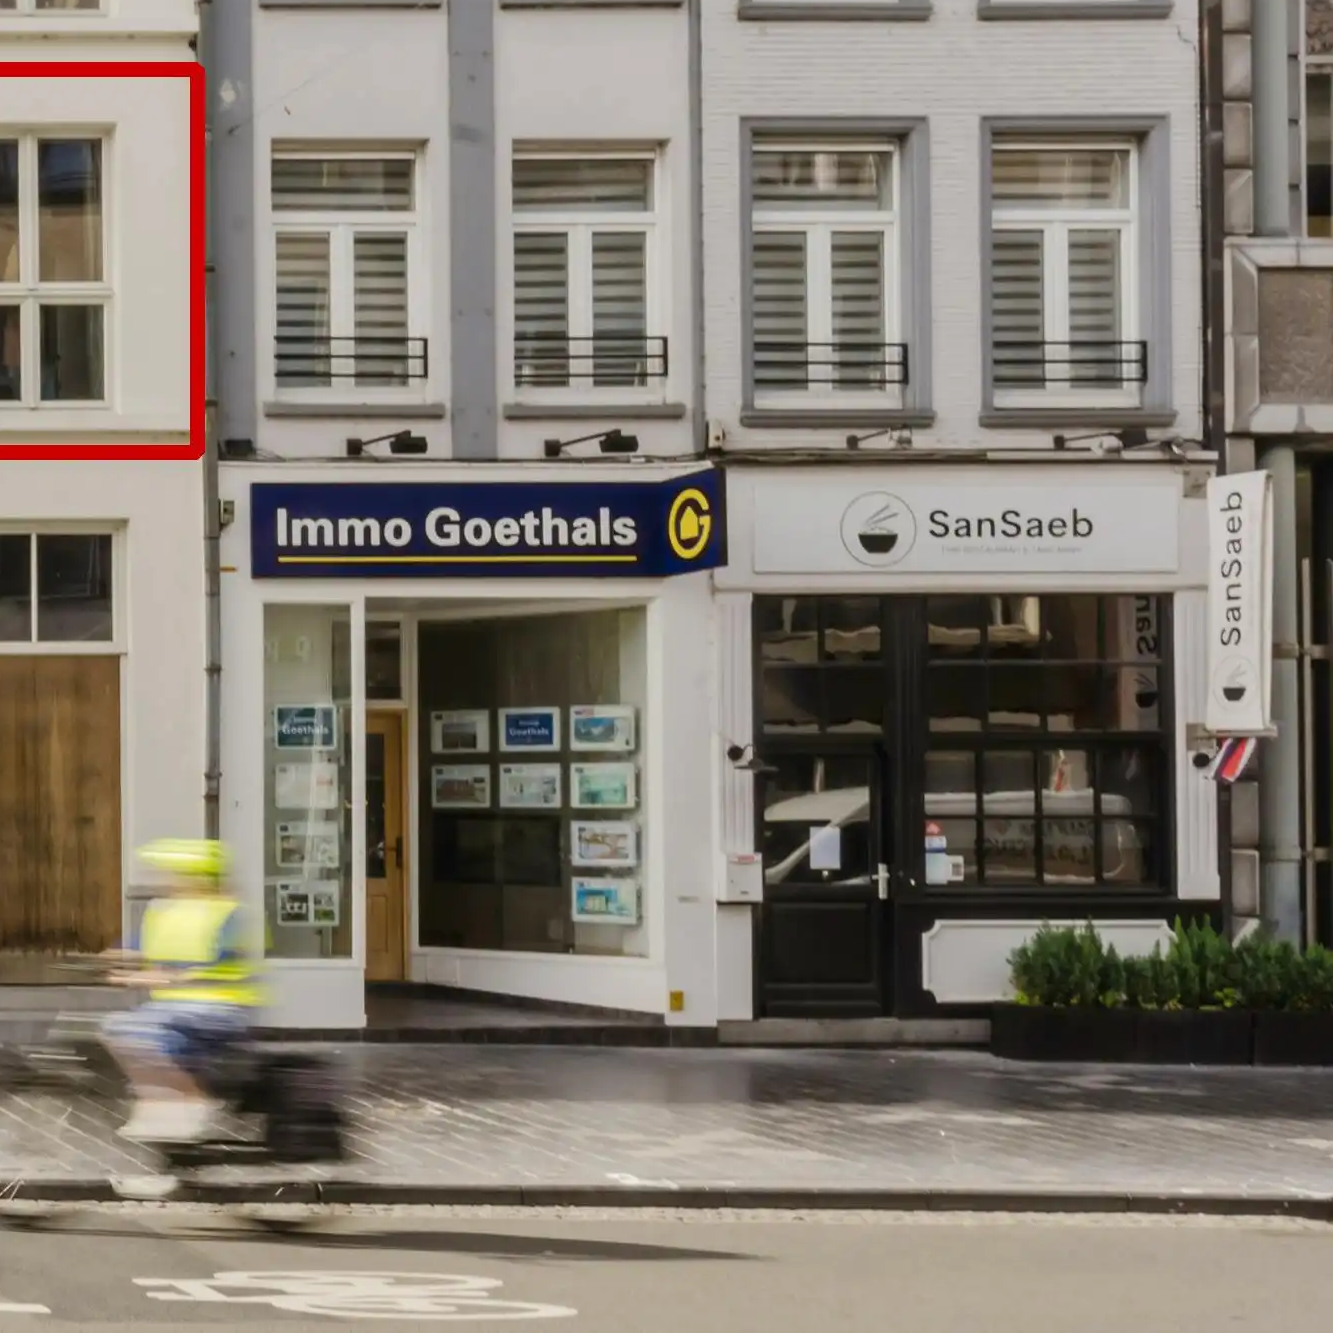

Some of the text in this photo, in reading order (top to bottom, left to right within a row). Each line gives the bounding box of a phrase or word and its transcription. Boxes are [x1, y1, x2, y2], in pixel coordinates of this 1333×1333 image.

[276, 506, 638, 547] Immo Goethals
[929, 508, 1094, 538] SanSaeb
[1220, 491, 1243, 646] SanSaeb
